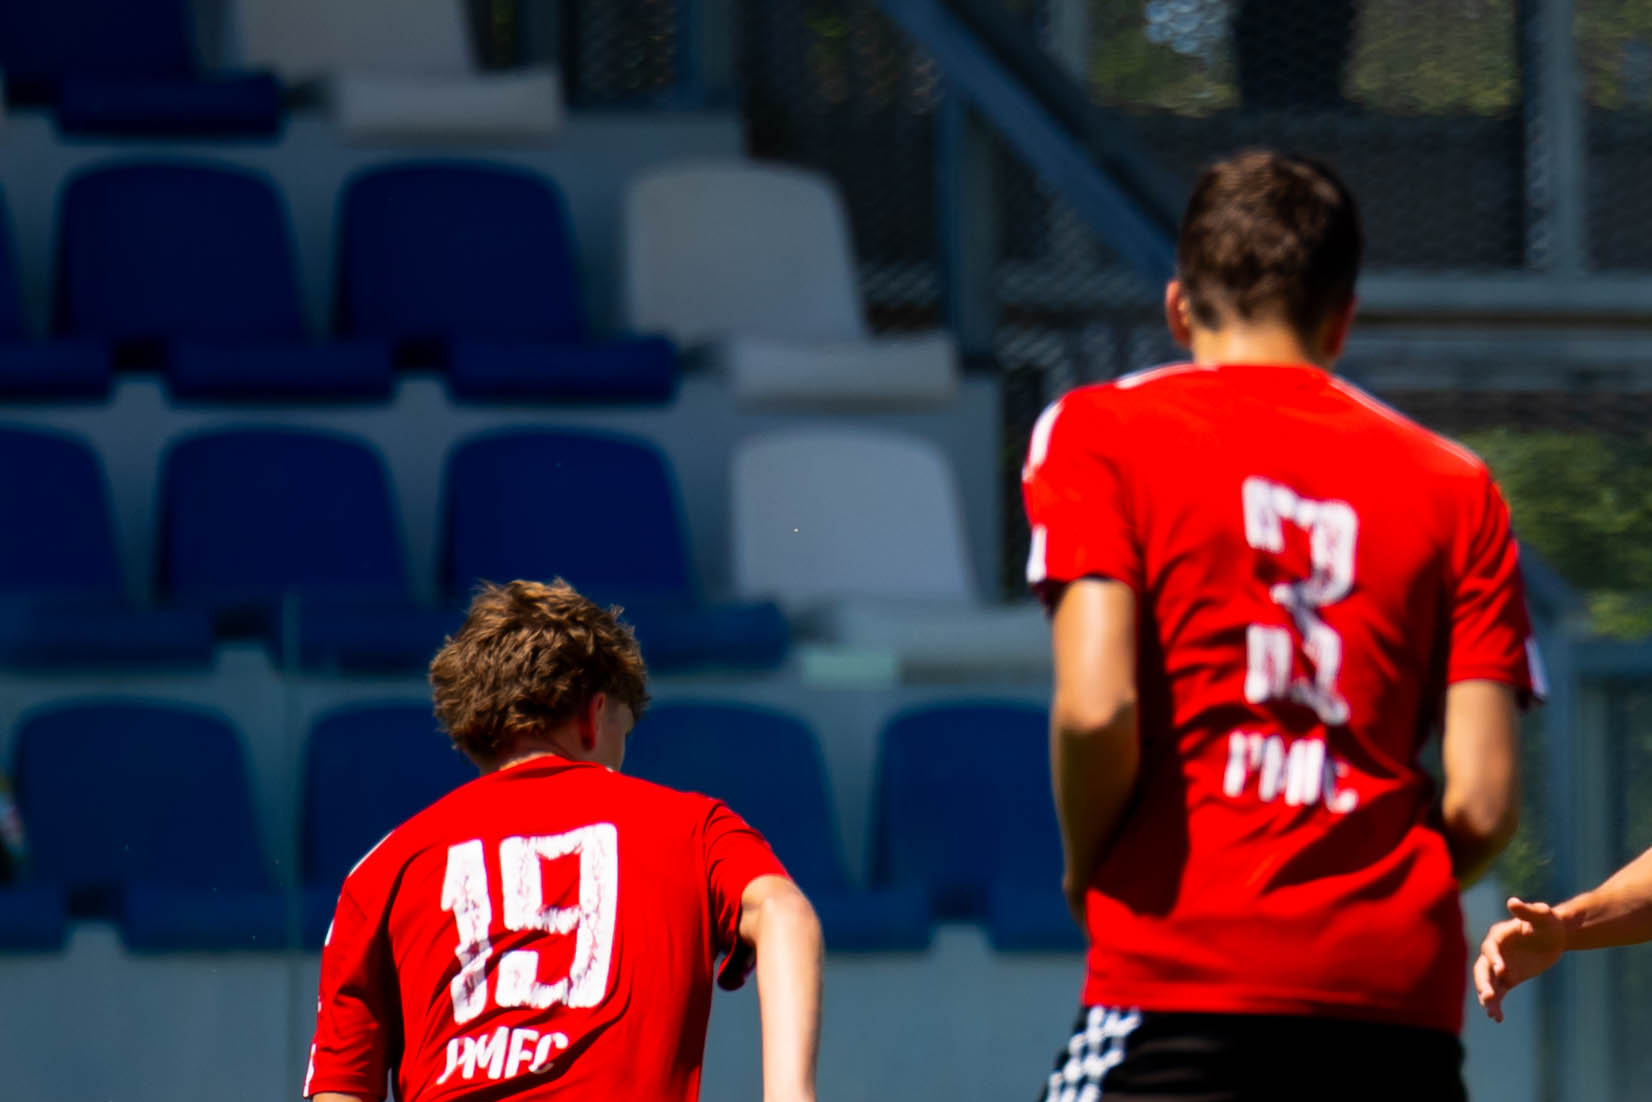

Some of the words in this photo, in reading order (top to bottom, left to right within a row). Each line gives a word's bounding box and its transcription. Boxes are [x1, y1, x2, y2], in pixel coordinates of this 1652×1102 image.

[1242, 476, 1359, 725] 3
[440, 822, 619, 1025] 19
[436, 1026, 569, 1086] PMFC
